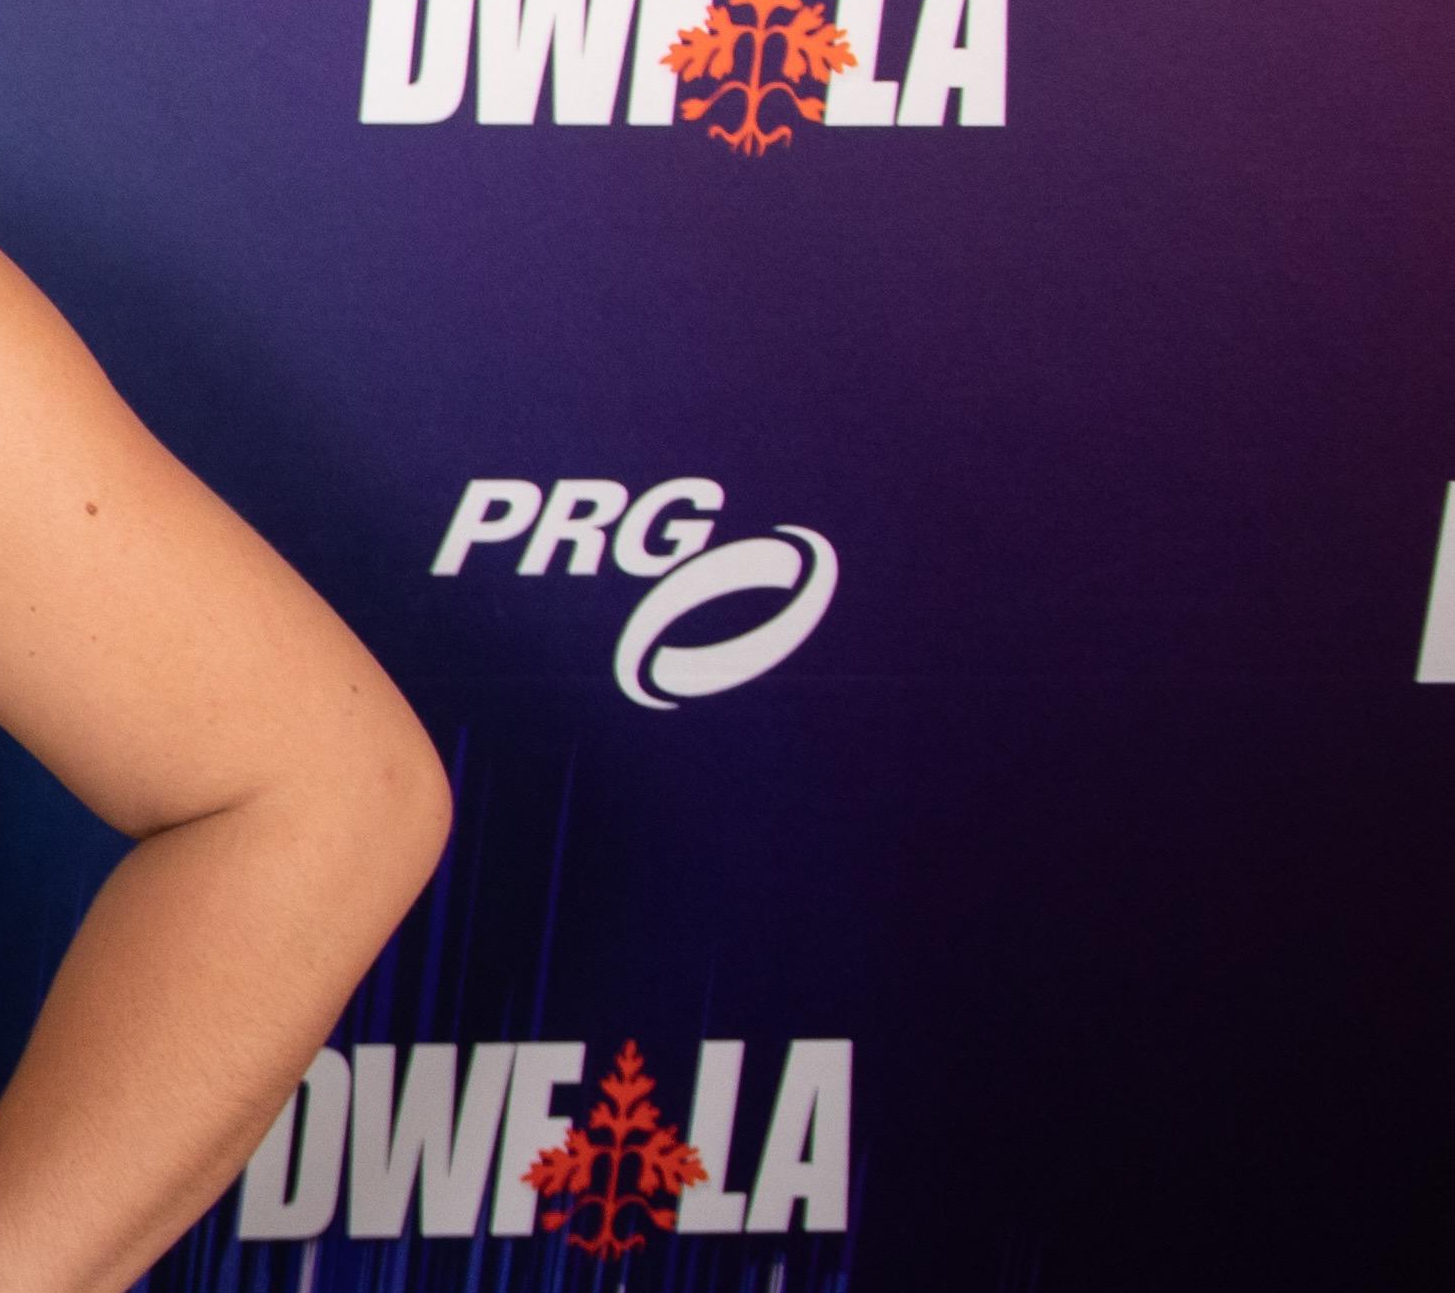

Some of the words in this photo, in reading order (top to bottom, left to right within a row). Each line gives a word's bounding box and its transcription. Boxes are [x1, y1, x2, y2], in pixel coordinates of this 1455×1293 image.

[431, 477, 725, 577] PRG
[237, 1040, 586, 1240] DWF
[676, 1039, 852, 1233] LA
